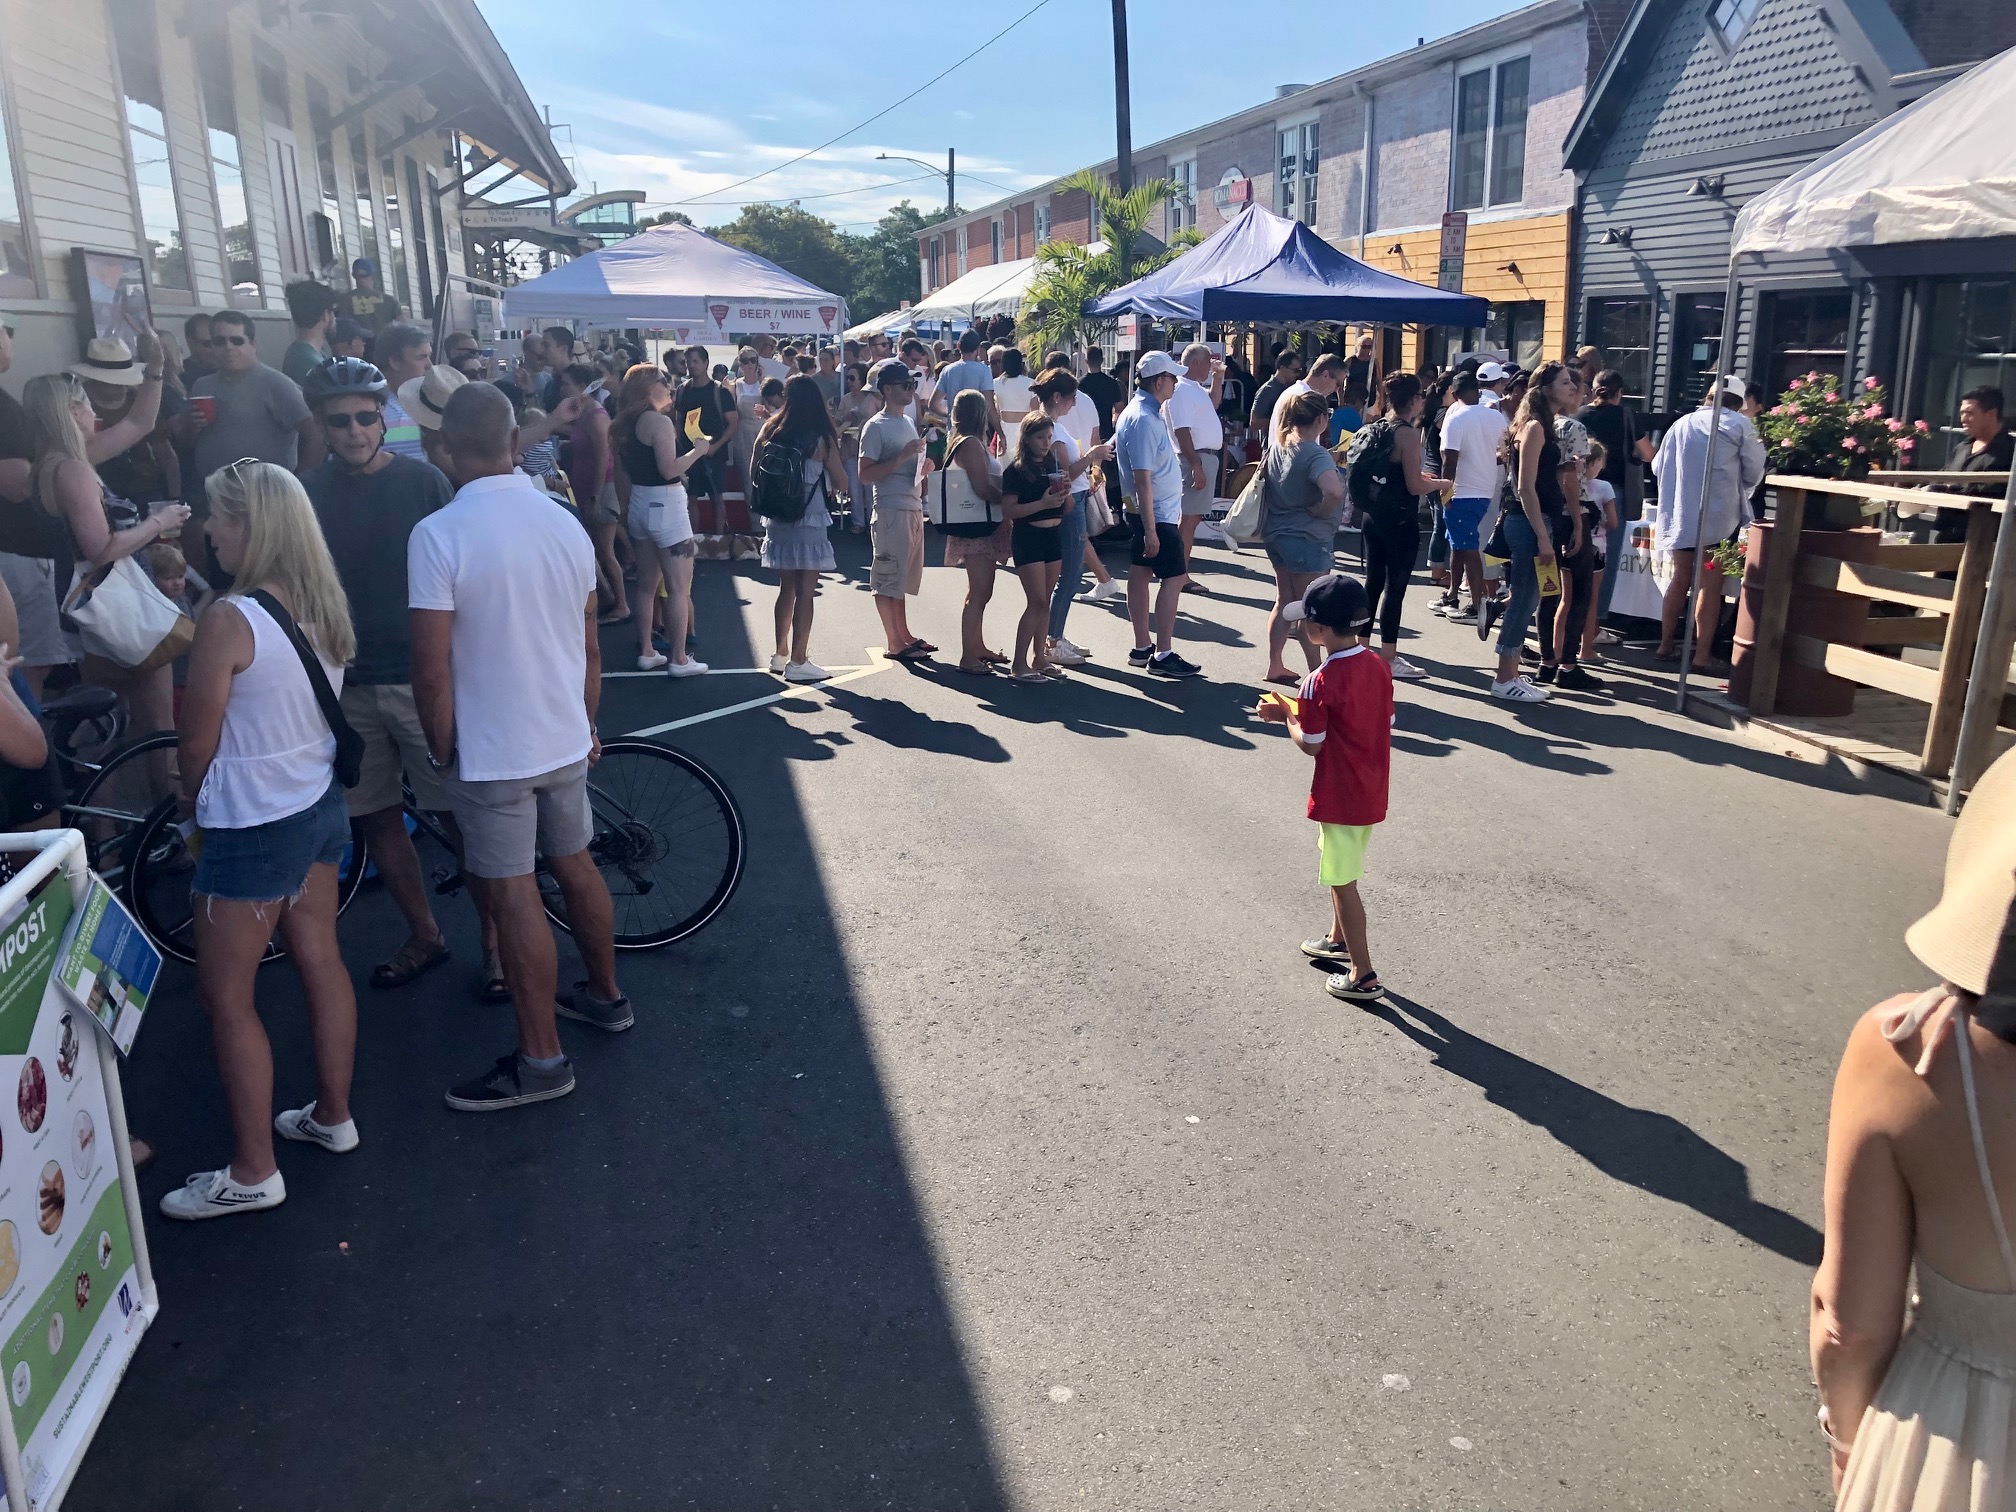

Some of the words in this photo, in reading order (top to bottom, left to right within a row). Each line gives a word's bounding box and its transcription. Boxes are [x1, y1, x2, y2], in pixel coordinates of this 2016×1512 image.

[1446, 228, 1451, 236] 2
[1441, 262, 1447, 270] 2
[739, 308, 772, 319] BEER
[774, 309, 778, 319] /
[781, 309, 812, 319] WINE
[769, 321, 781, 330] $7
[1620, 553, 1674, 579] arvest
[66, 954, 77, 979] WANT
[75, 942, 82, 953] TO
[80, 911, 93, 941] DIVERT
[91, 888, 102, 912] FOOD
[74, 945, 88, 973] WASTE
[86, 933, 92, 945] AT
